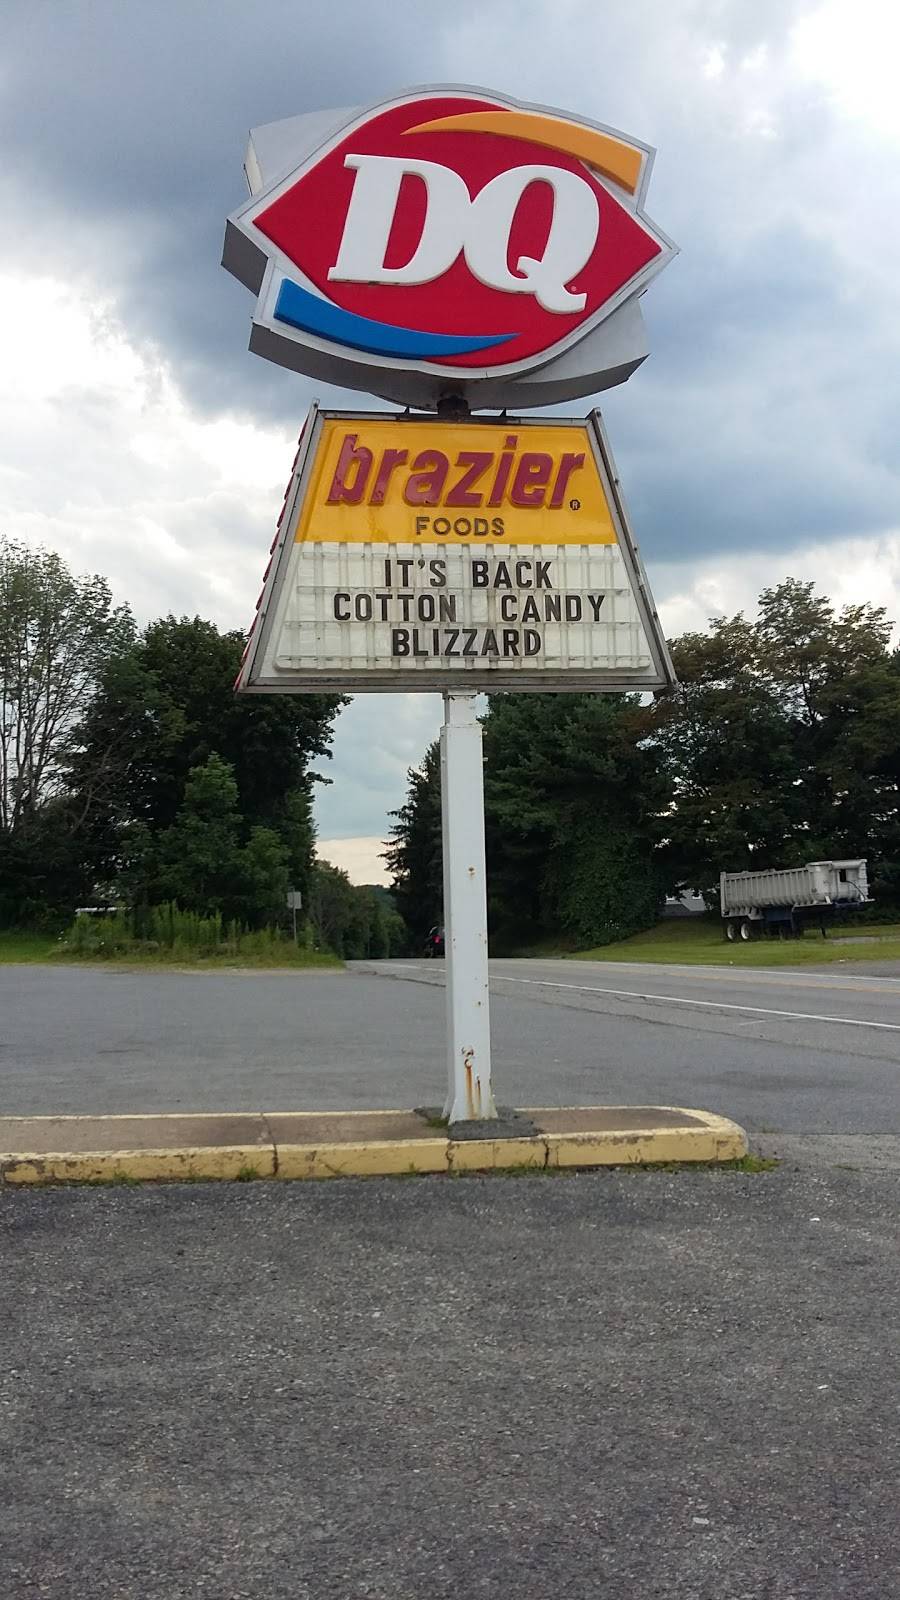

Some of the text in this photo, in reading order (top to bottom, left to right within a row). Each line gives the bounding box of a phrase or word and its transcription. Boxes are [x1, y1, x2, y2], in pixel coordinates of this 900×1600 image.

[327, 153, 600, 315] DQ
[325, 434, 586, 510] brazier
[415, 516, 505, 537] FOODS
[384, 559, 553, 589] IT'S BACK
[333, 593, 605, 623] COTTON CANDY
[391, 628, 542, 657] BLIZZARD
